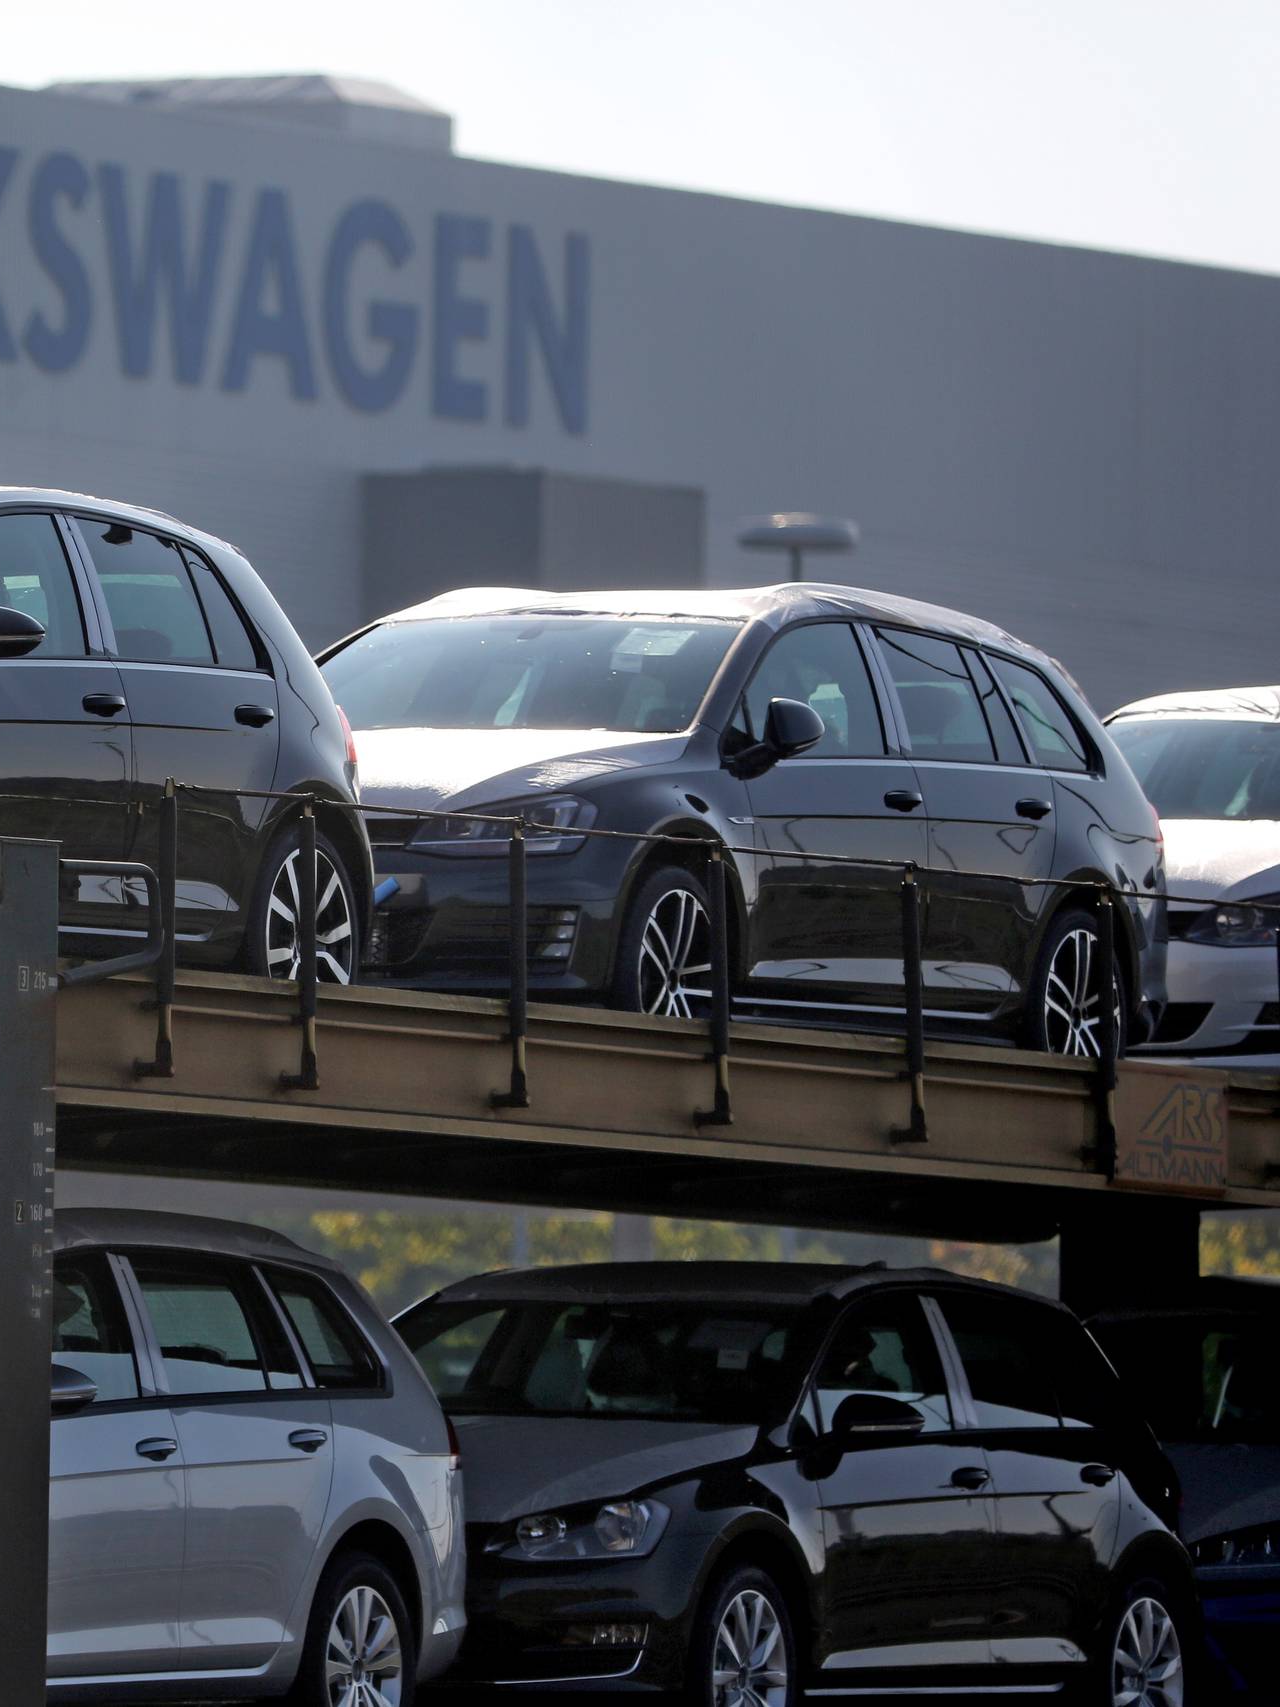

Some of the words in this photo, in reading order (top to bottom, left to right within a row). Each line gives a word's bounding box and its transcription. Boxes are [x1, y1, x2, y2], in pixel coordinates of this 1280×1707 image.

[33, 972, 46, 990] 215
[1139, 1083, 1222, 1147] ARS
[1121, 1151, 1223, 1185] ALTMANN
[30, 1204, 43, 1221] 160
